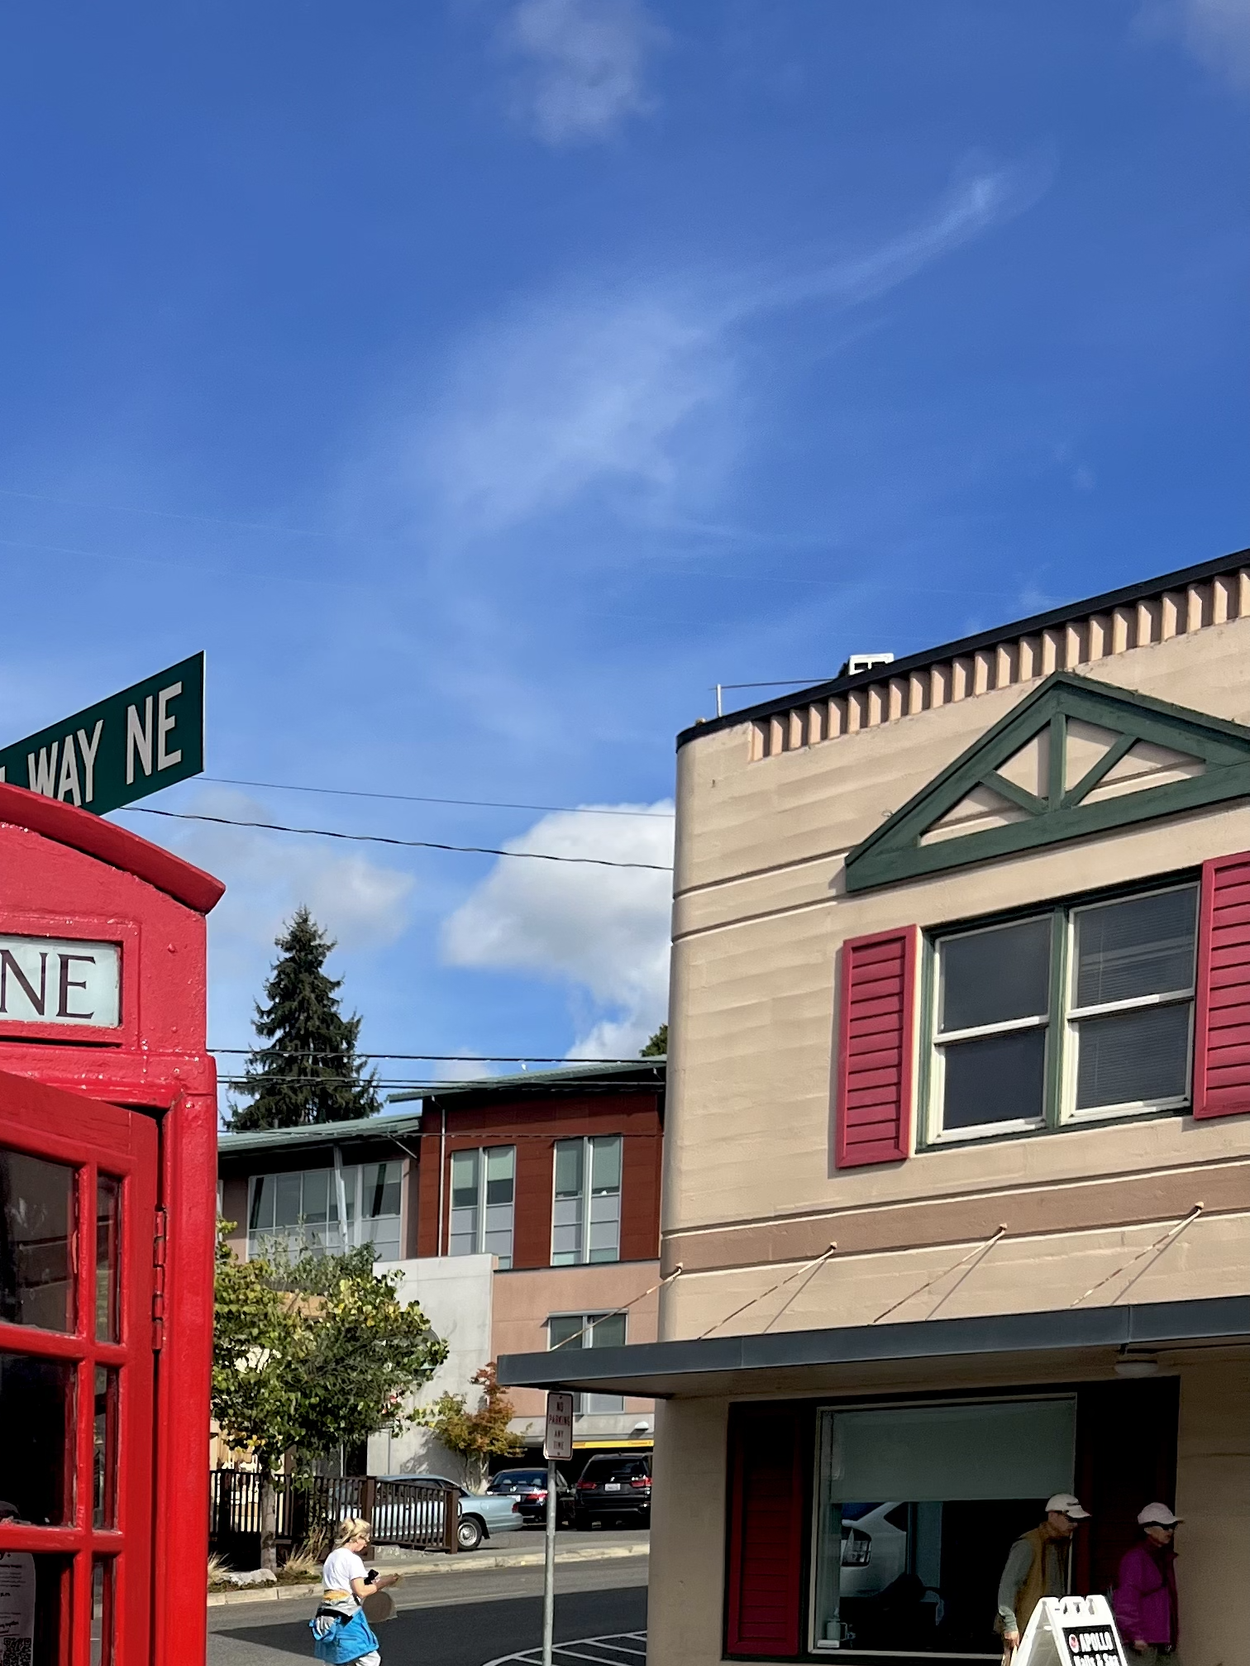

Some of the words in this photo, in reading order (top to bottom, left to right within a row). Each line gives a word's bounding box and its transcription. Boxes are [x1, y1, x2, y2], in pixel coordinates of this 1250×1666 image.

[28, 719, 104, 807] WAY
[126, 680, 182, 785] NE
[1079, 1632, 1113, 1652] APOLLO
